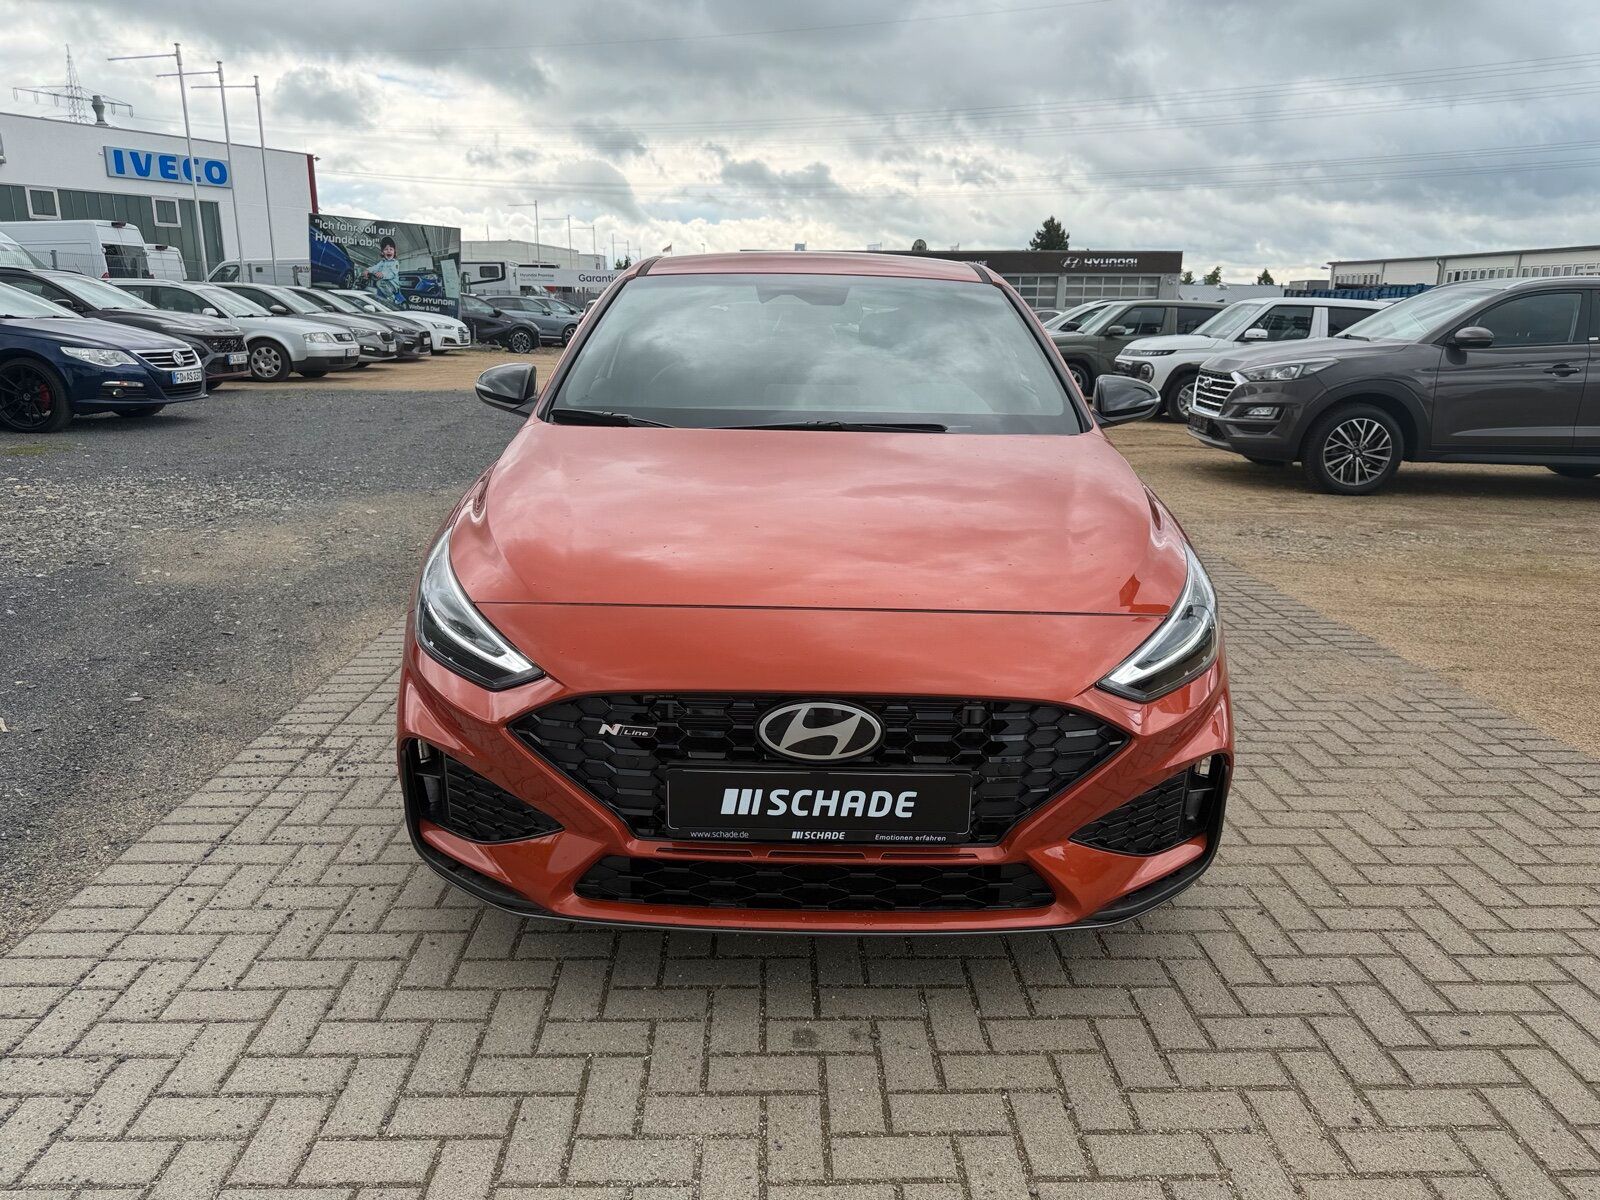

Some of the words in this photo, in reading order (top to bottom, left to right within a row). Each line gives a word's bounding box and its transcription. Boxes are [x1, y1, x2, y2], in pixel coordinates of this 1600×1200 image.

[113, 149, 227, 185] IVECO
[337, 222, 356, 232] fahr
[358, 225, 377, 235] voll
[379, 227, 396, 236] auf
[315, 233, 357, 246] Hyundai
[1084, 258, 1138, 267] HYUNDAI
[422, 297, 456, 306] HYUNDAI
[598, 723, 622, 736] N
[623, 729, 649, 737] Line
[767, 788, 918, 818] SCHADE
[690, 830, 749, 839] www.schade.de
[804, 831, 846, 840] SCHADE
[874, 833, 913, 841] Emotionen
[915, 834, 947, 842] erfahren
